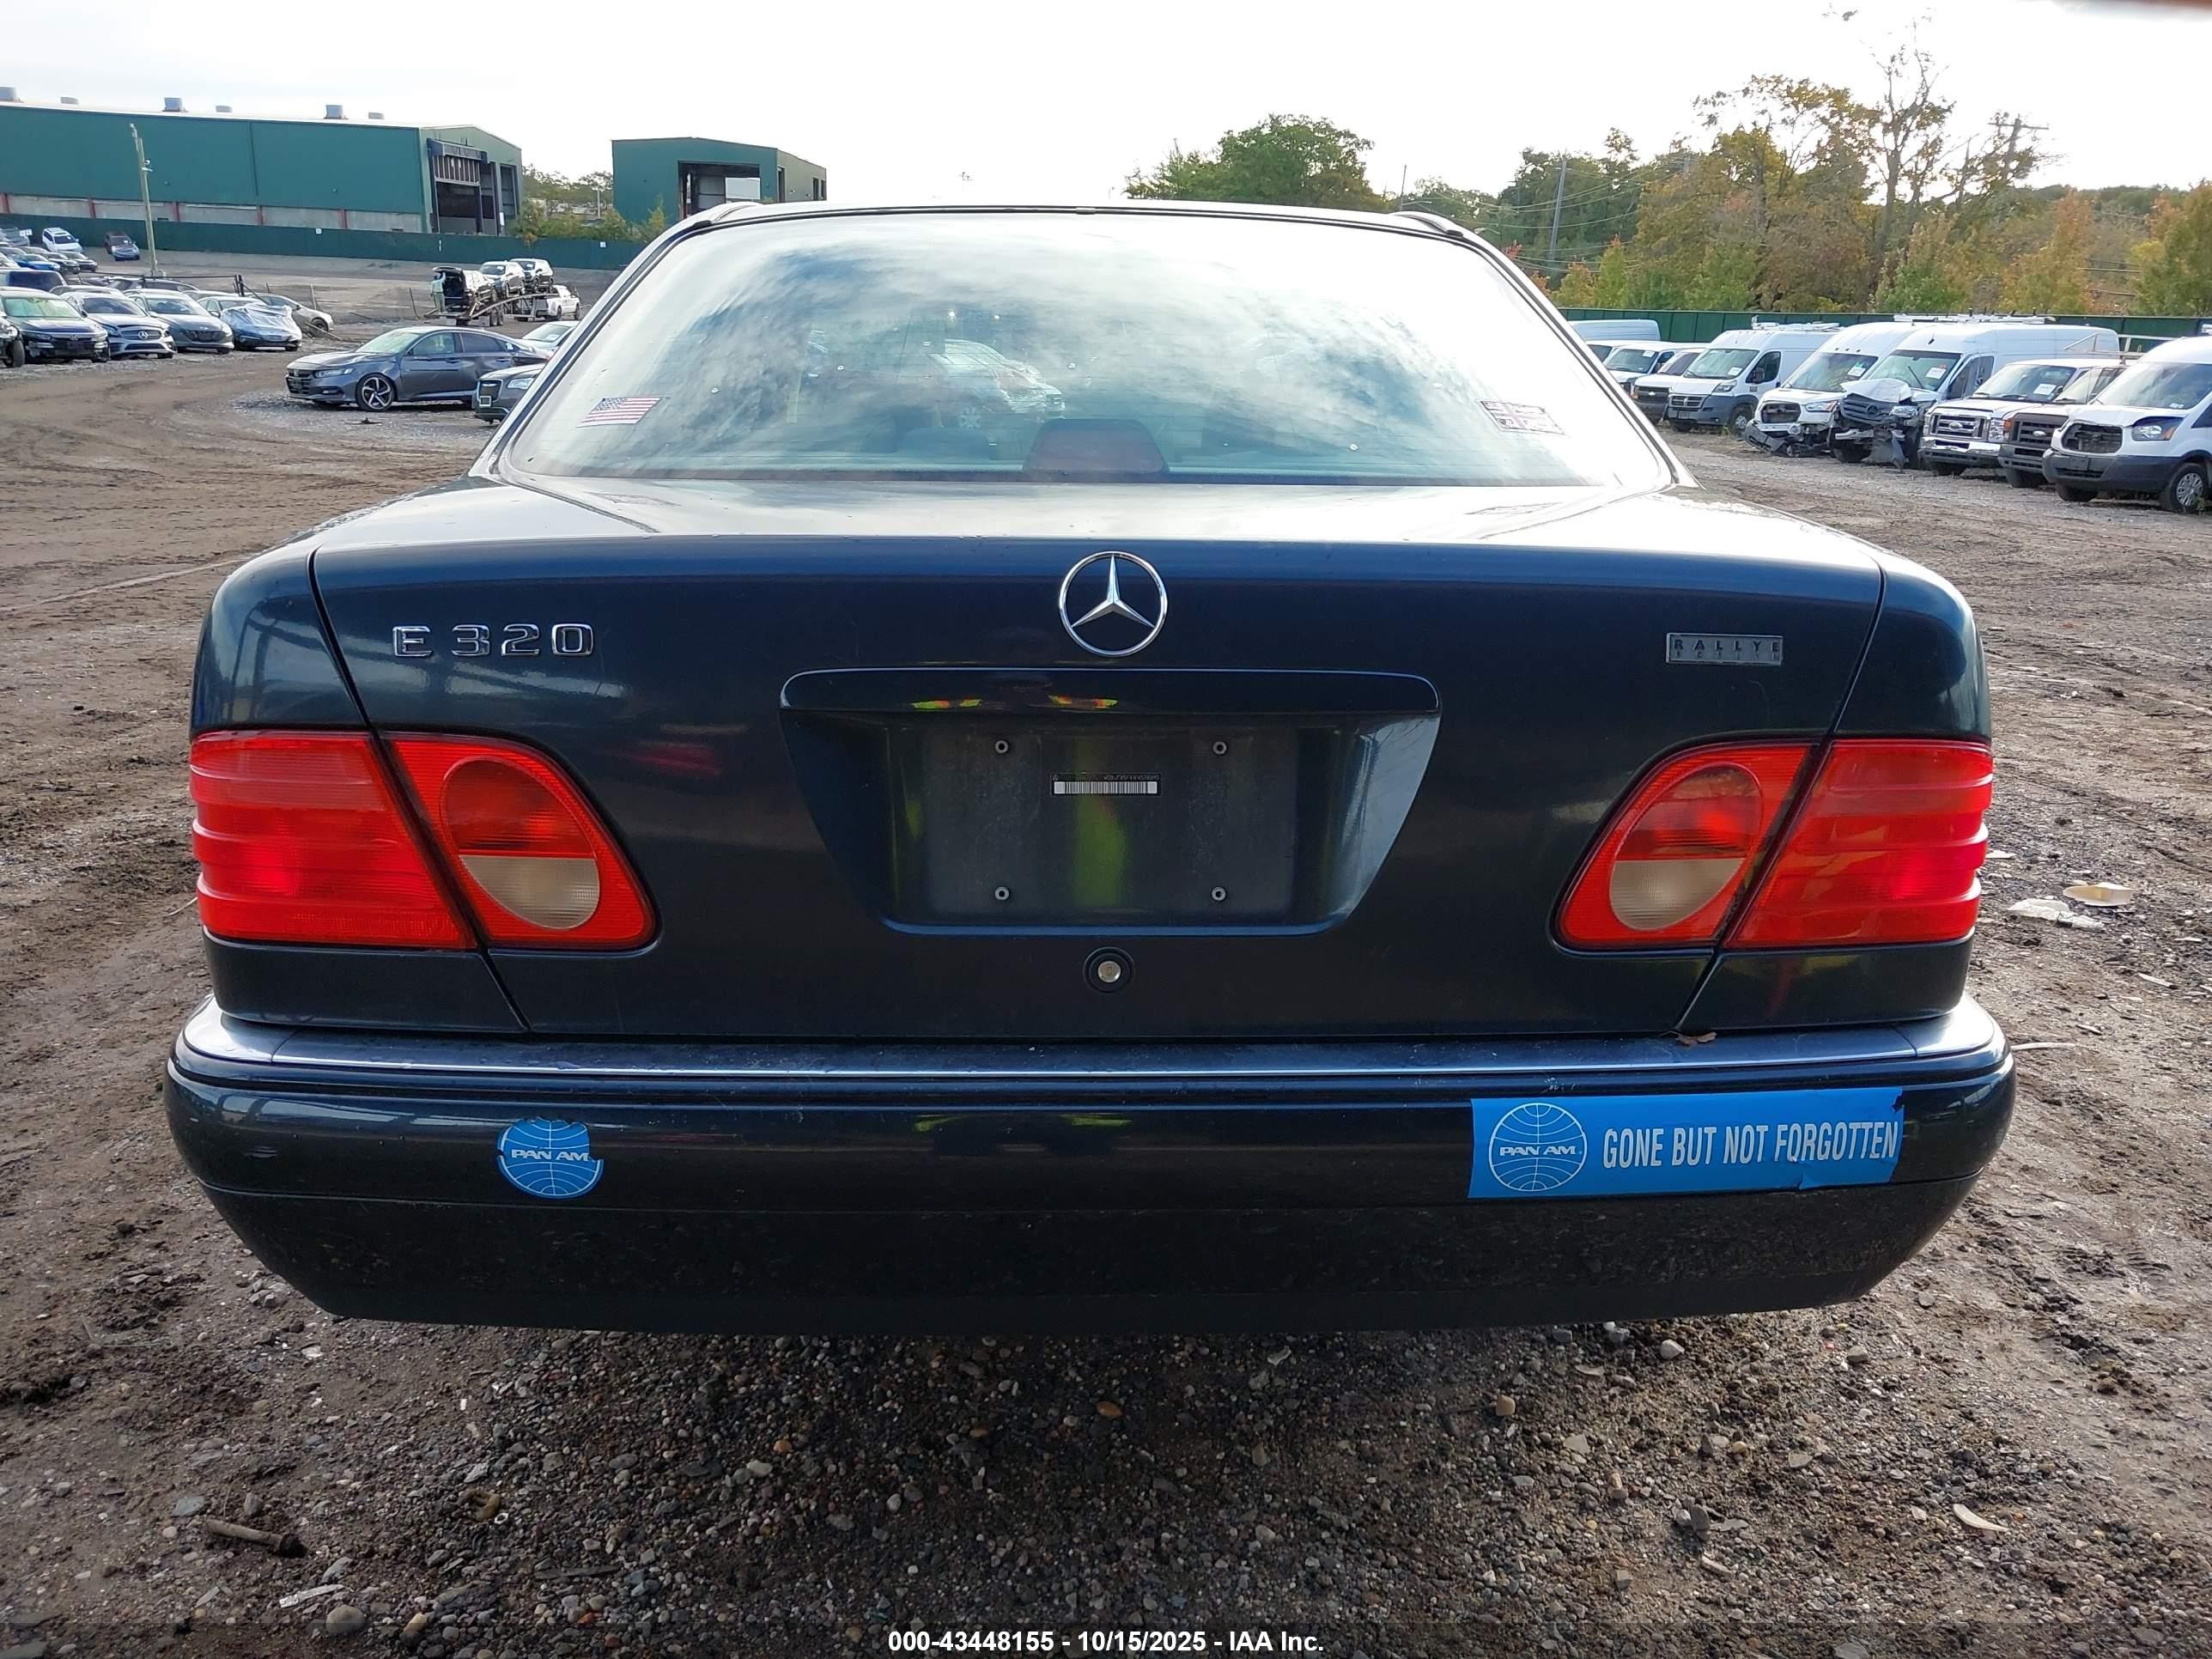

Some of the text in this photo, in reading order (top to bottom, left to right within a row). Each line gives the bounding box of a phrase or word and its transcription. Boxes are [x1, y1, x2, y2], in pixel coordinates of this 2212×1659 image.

[392, 623, 595, 657] E 320
[1674, 639, 1781, 653] RALLYE
[1499, 1145, 1577, 1157] PAN AM
[1602, 1121, 1899, 1169] GONE BUT NOT FORGOTTEN
[511, 1149, 590, 1162] PAN AM
